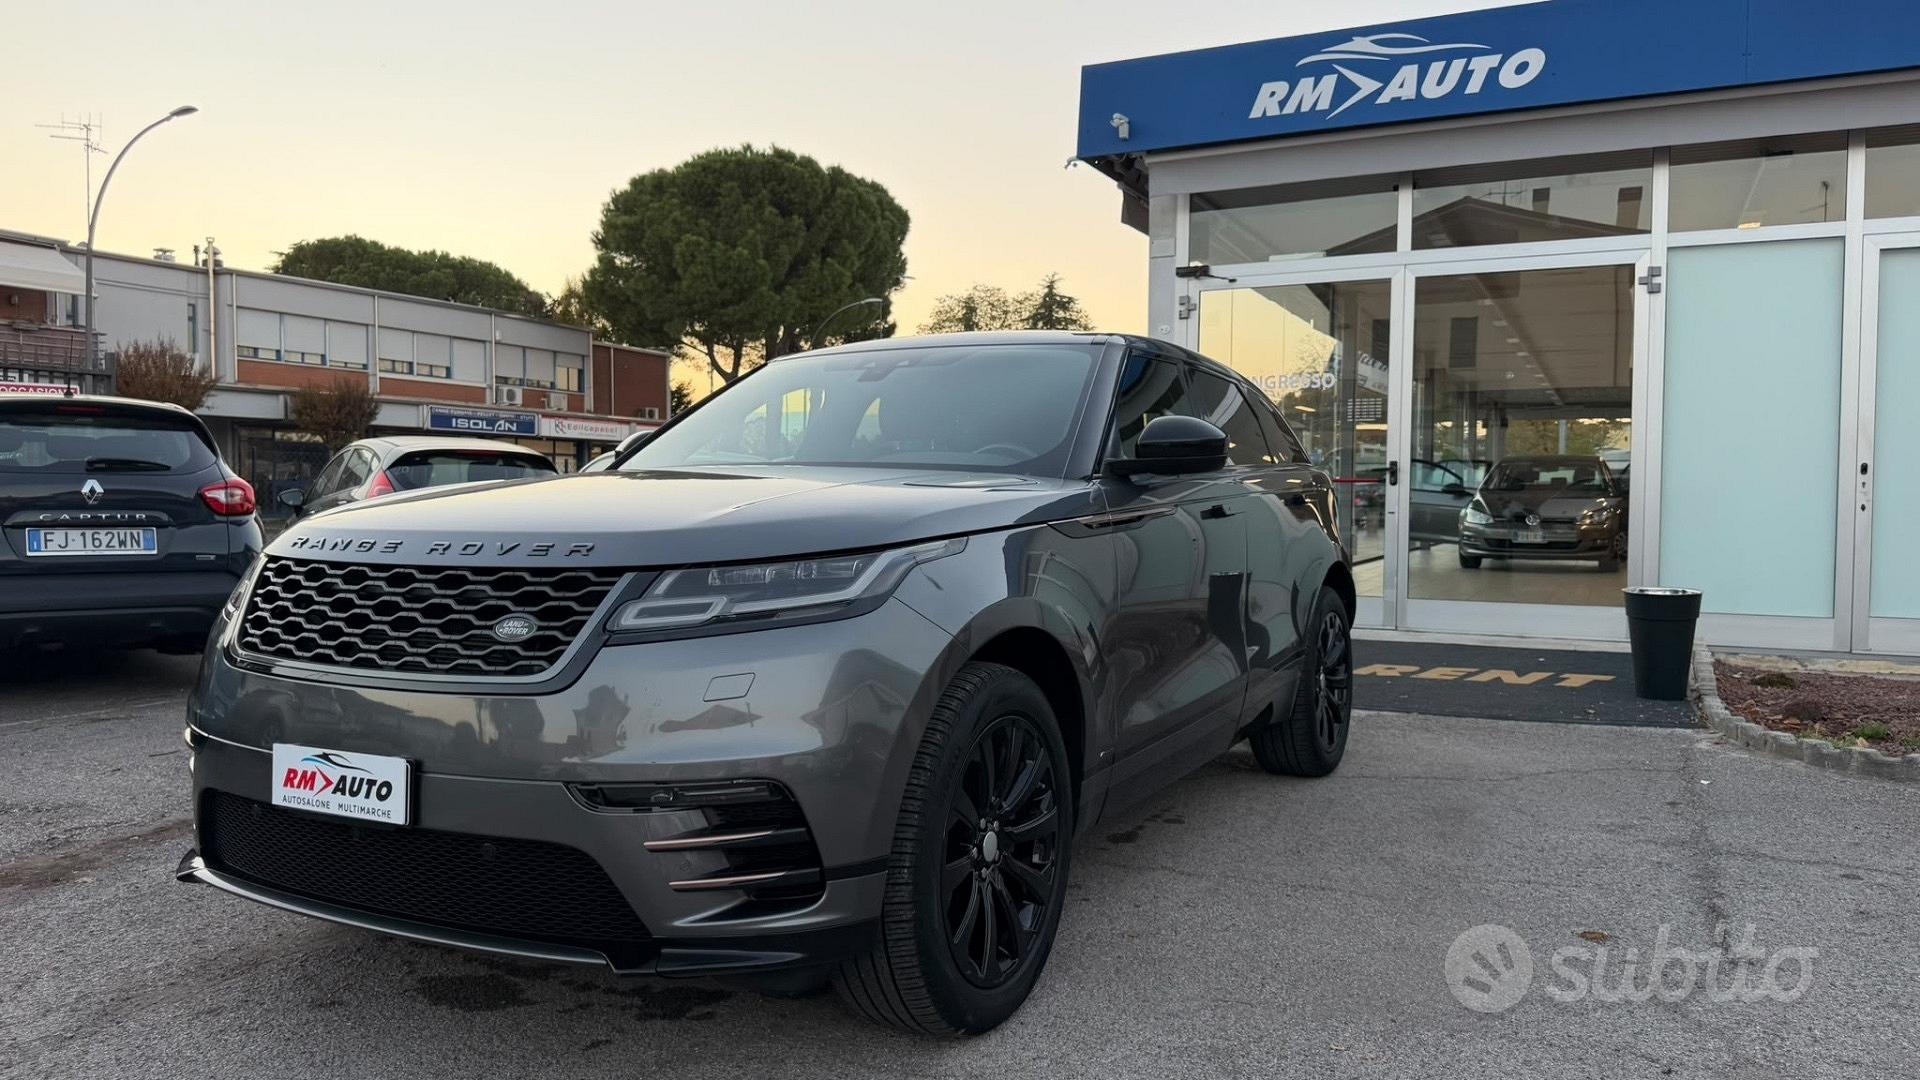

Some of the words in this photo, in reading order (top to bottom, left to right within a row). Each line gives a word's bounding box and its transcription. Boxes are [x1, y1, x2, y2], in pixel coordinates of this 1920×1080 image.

[1249, 74, 1338, 119] RM
[1374, 48, 1546, 105] AUTO
[1251, 372, 1336, 389] NGRESSO
[452, 418, 517, 432] ISOLAN
[39, 513, 147, 521] CAPTUR
[290, 536, 404, 554] RANGE
[425, 541, 596, 557] ROVER
[503, 627, 529, 635] ROVER
[1353, 663, 1617, 687] RENT
[282, 767, 317, 791] RM
[331, 774, 393, 802] AUTO
[282, 794, 331, 810] AUTOSALONE
[337, 802, 392, 819] MULTIMARCHE
